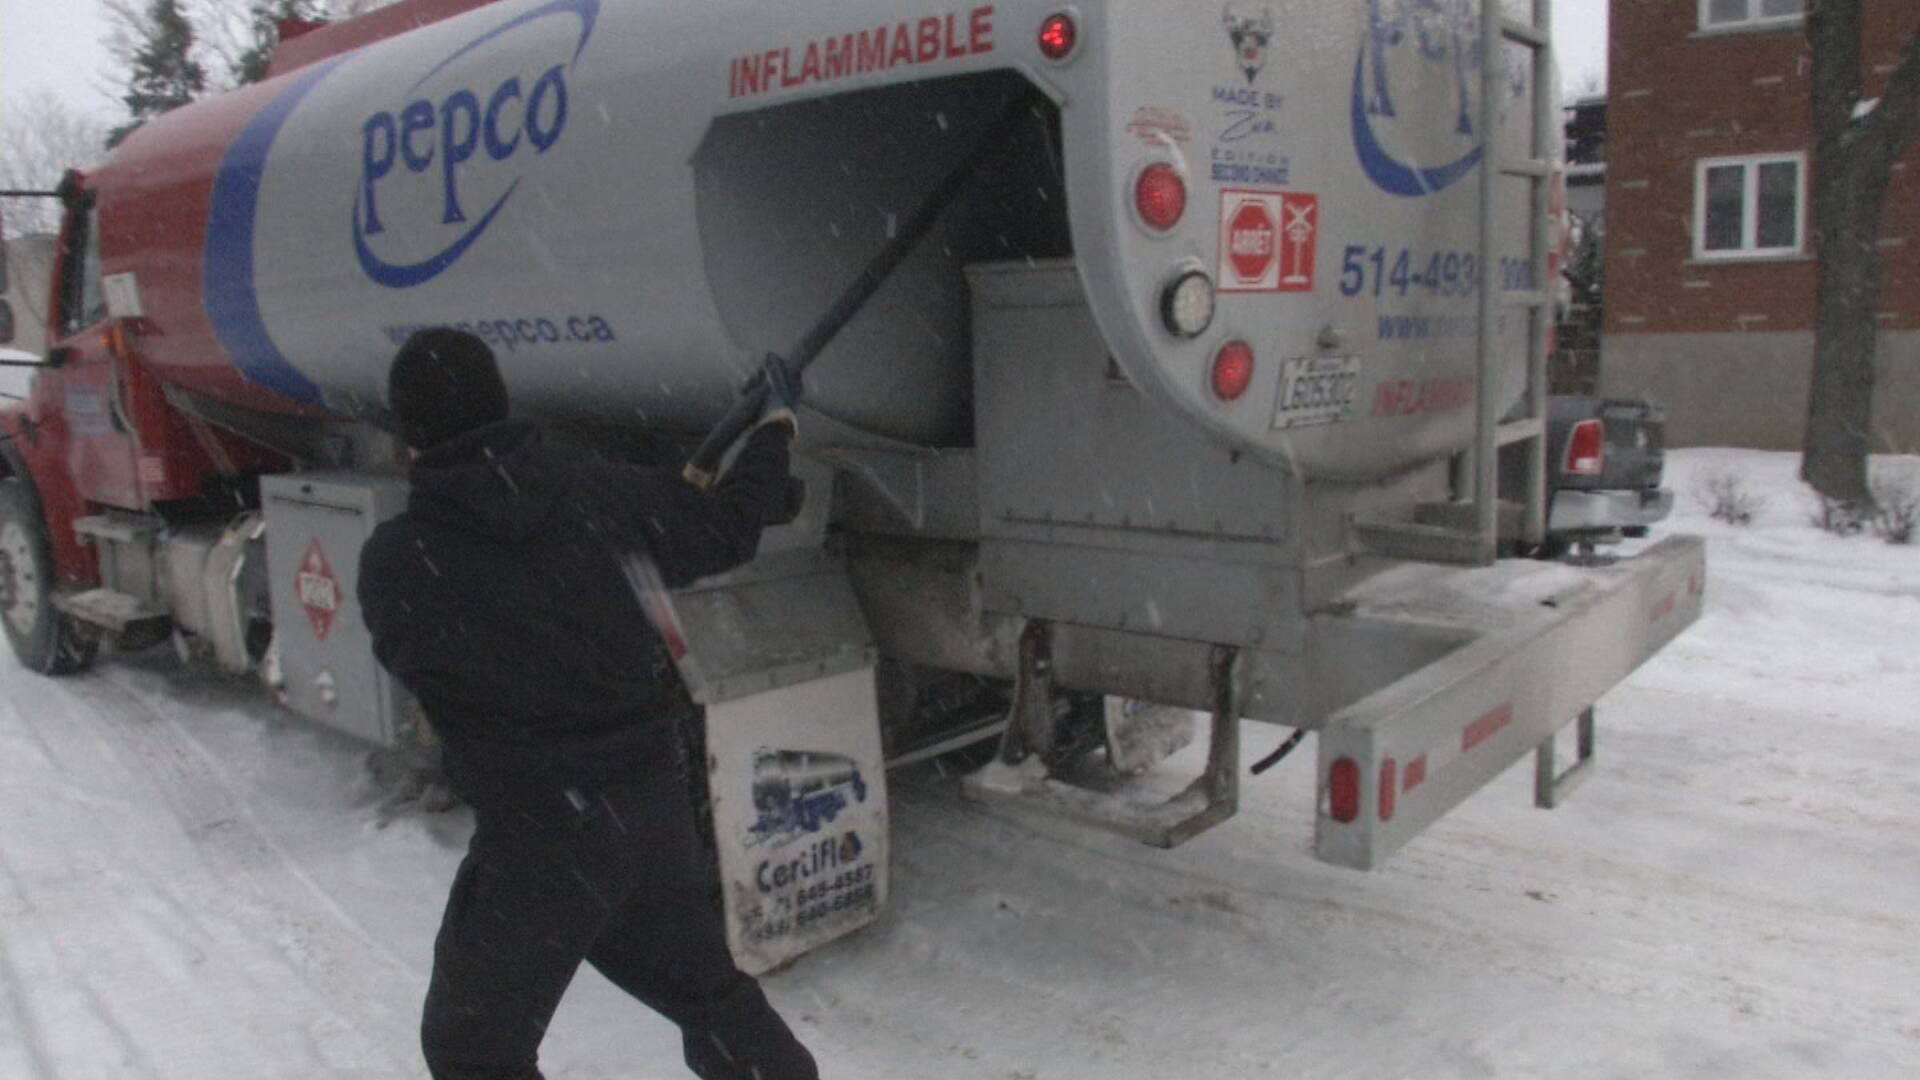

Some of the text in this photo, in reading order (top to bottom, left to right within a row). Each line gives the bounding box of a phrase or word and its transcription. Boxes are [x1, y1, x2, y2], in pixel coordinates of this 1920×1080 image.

[730, 4, 995, 98] INFLAMMABLE
[1211, 86, 1261, 107] MADE
[363, 62, 568, 234] pepco
